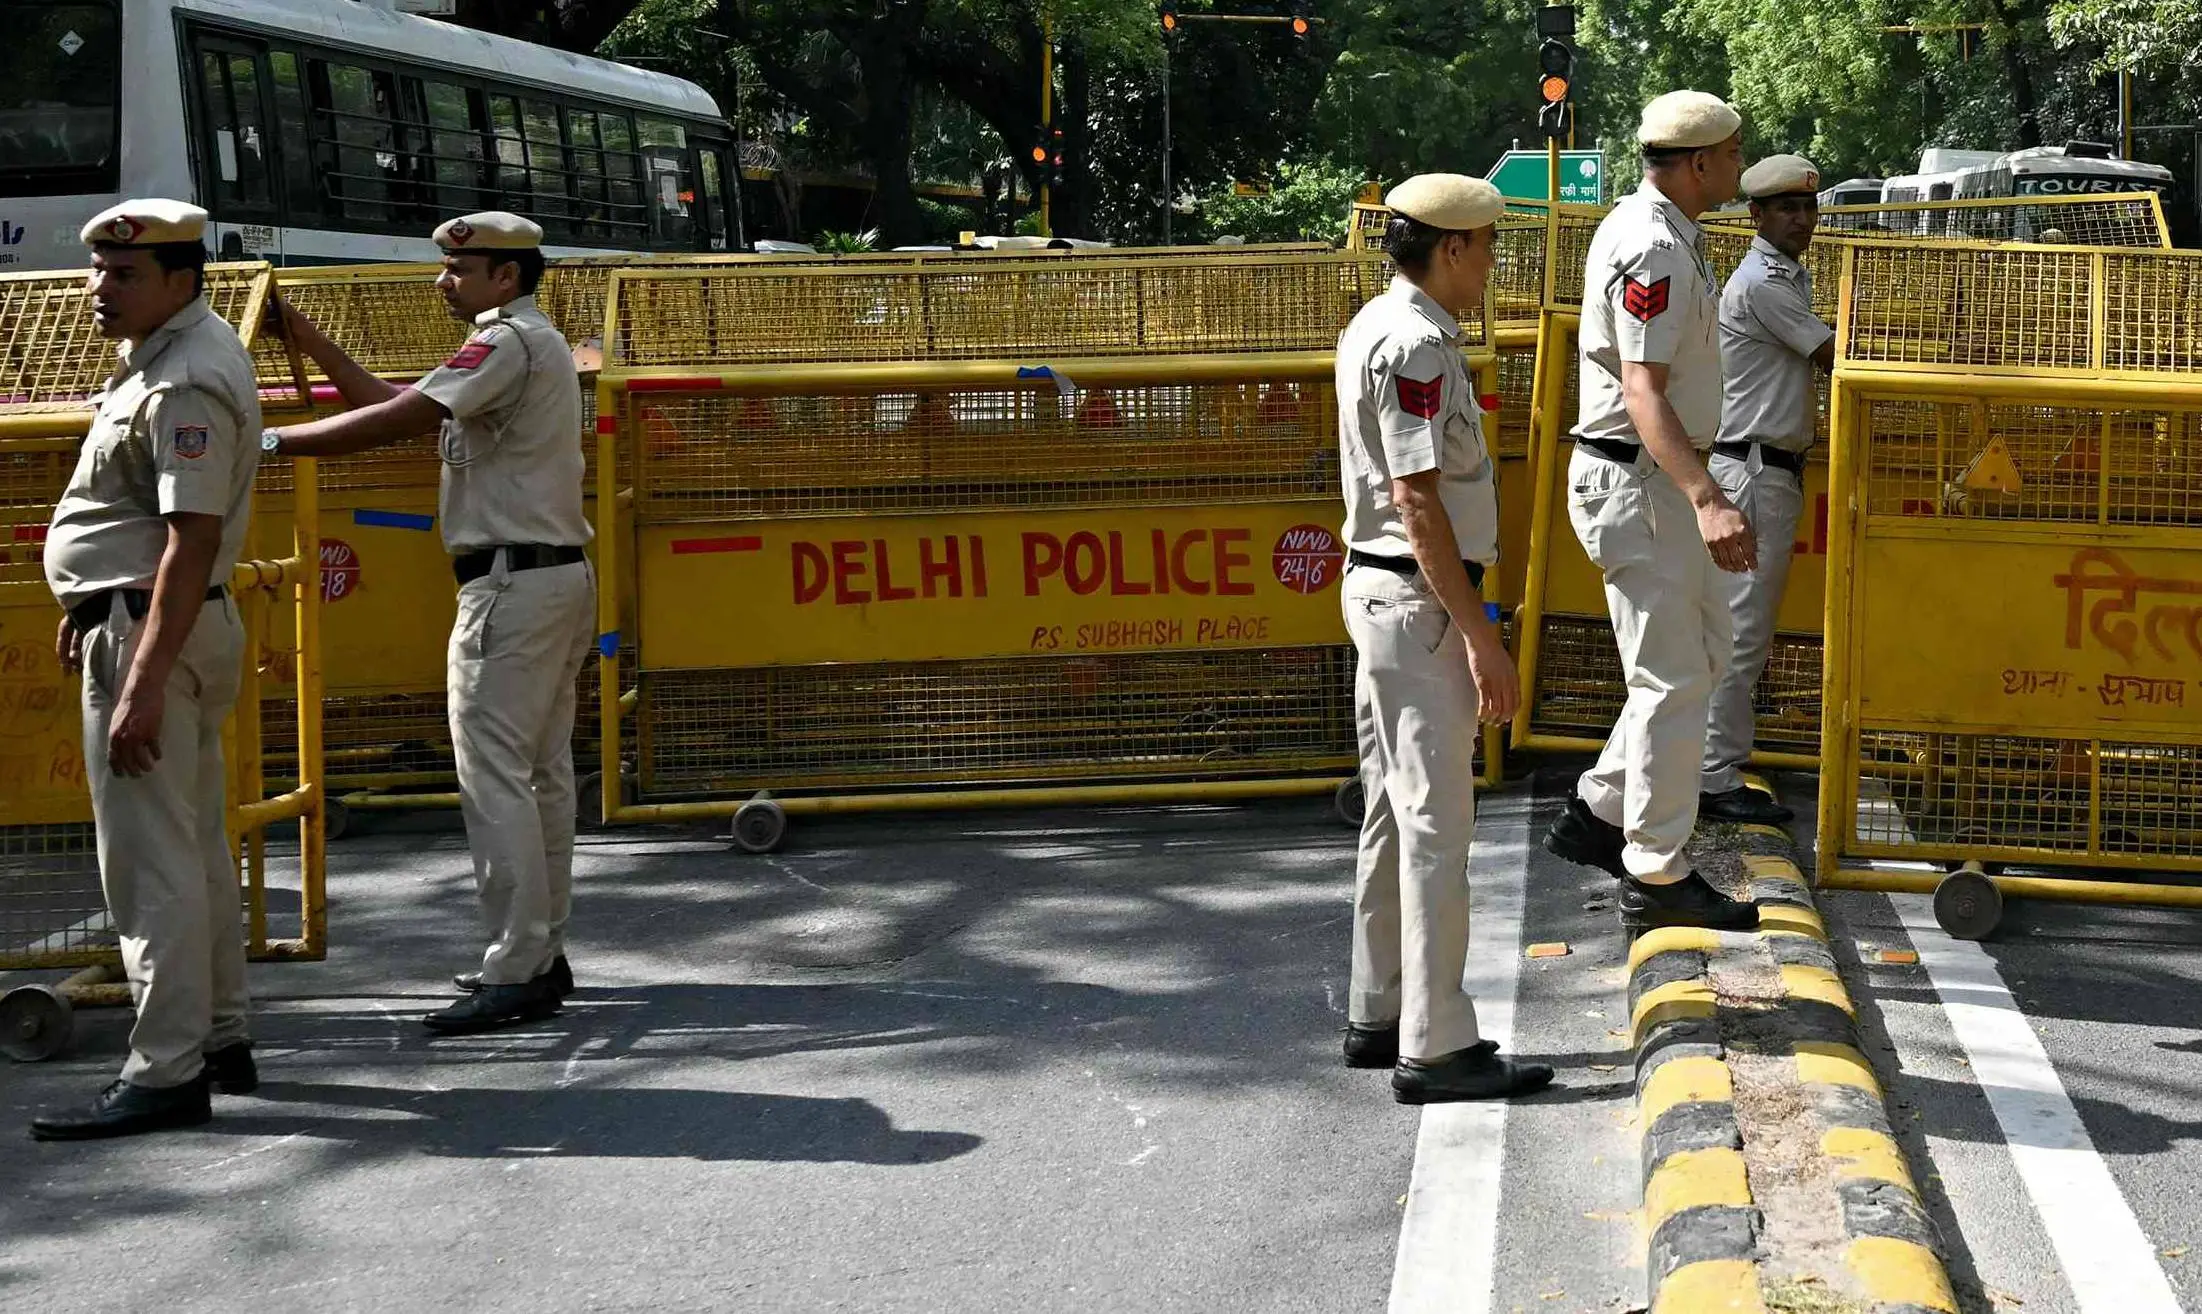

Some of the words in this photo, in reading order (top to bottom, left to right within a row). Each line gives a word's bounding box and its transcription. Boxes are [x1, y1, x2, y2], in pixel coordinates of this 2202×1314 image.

[1581, 182, 1597, 197] मार्ग
[2019, 179, 2167, 195] TOURIST
[1281, 530, 1332, 551] NWD
[320, 545, 351, 565] WD
[791, 535, 987, 606] DELHI
[1020, 528, 1254, 597] POLICE
[1076, 617, 1183, 649] SUBHASH
[1196, 614, 1271, 644] PLACE
[2001, 669, 2074, 698] थाना
